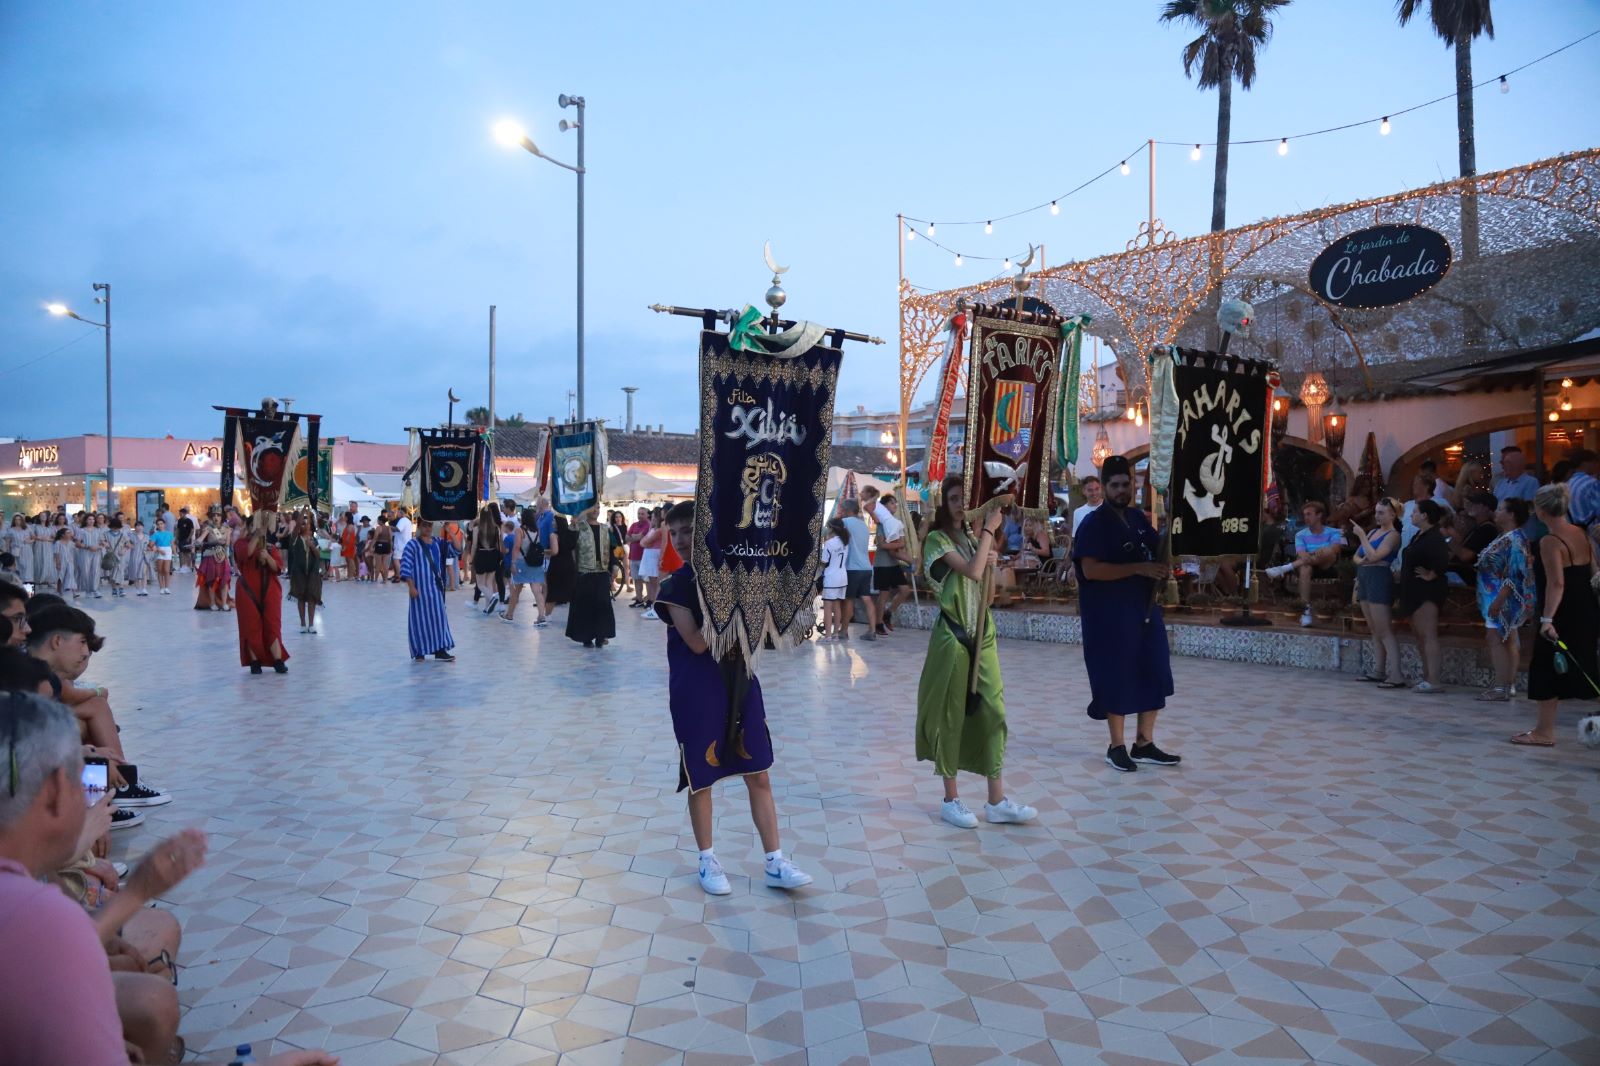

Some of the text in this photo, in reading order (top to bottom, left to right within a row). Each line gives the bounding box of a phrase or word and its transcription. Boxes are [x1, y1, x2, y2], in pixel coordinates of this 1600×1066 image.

[1343, 231, 1410, 255] Le jardin de
[1325, 248, 1439, 300] Chabada
[838, 552, 844, 568] 7
